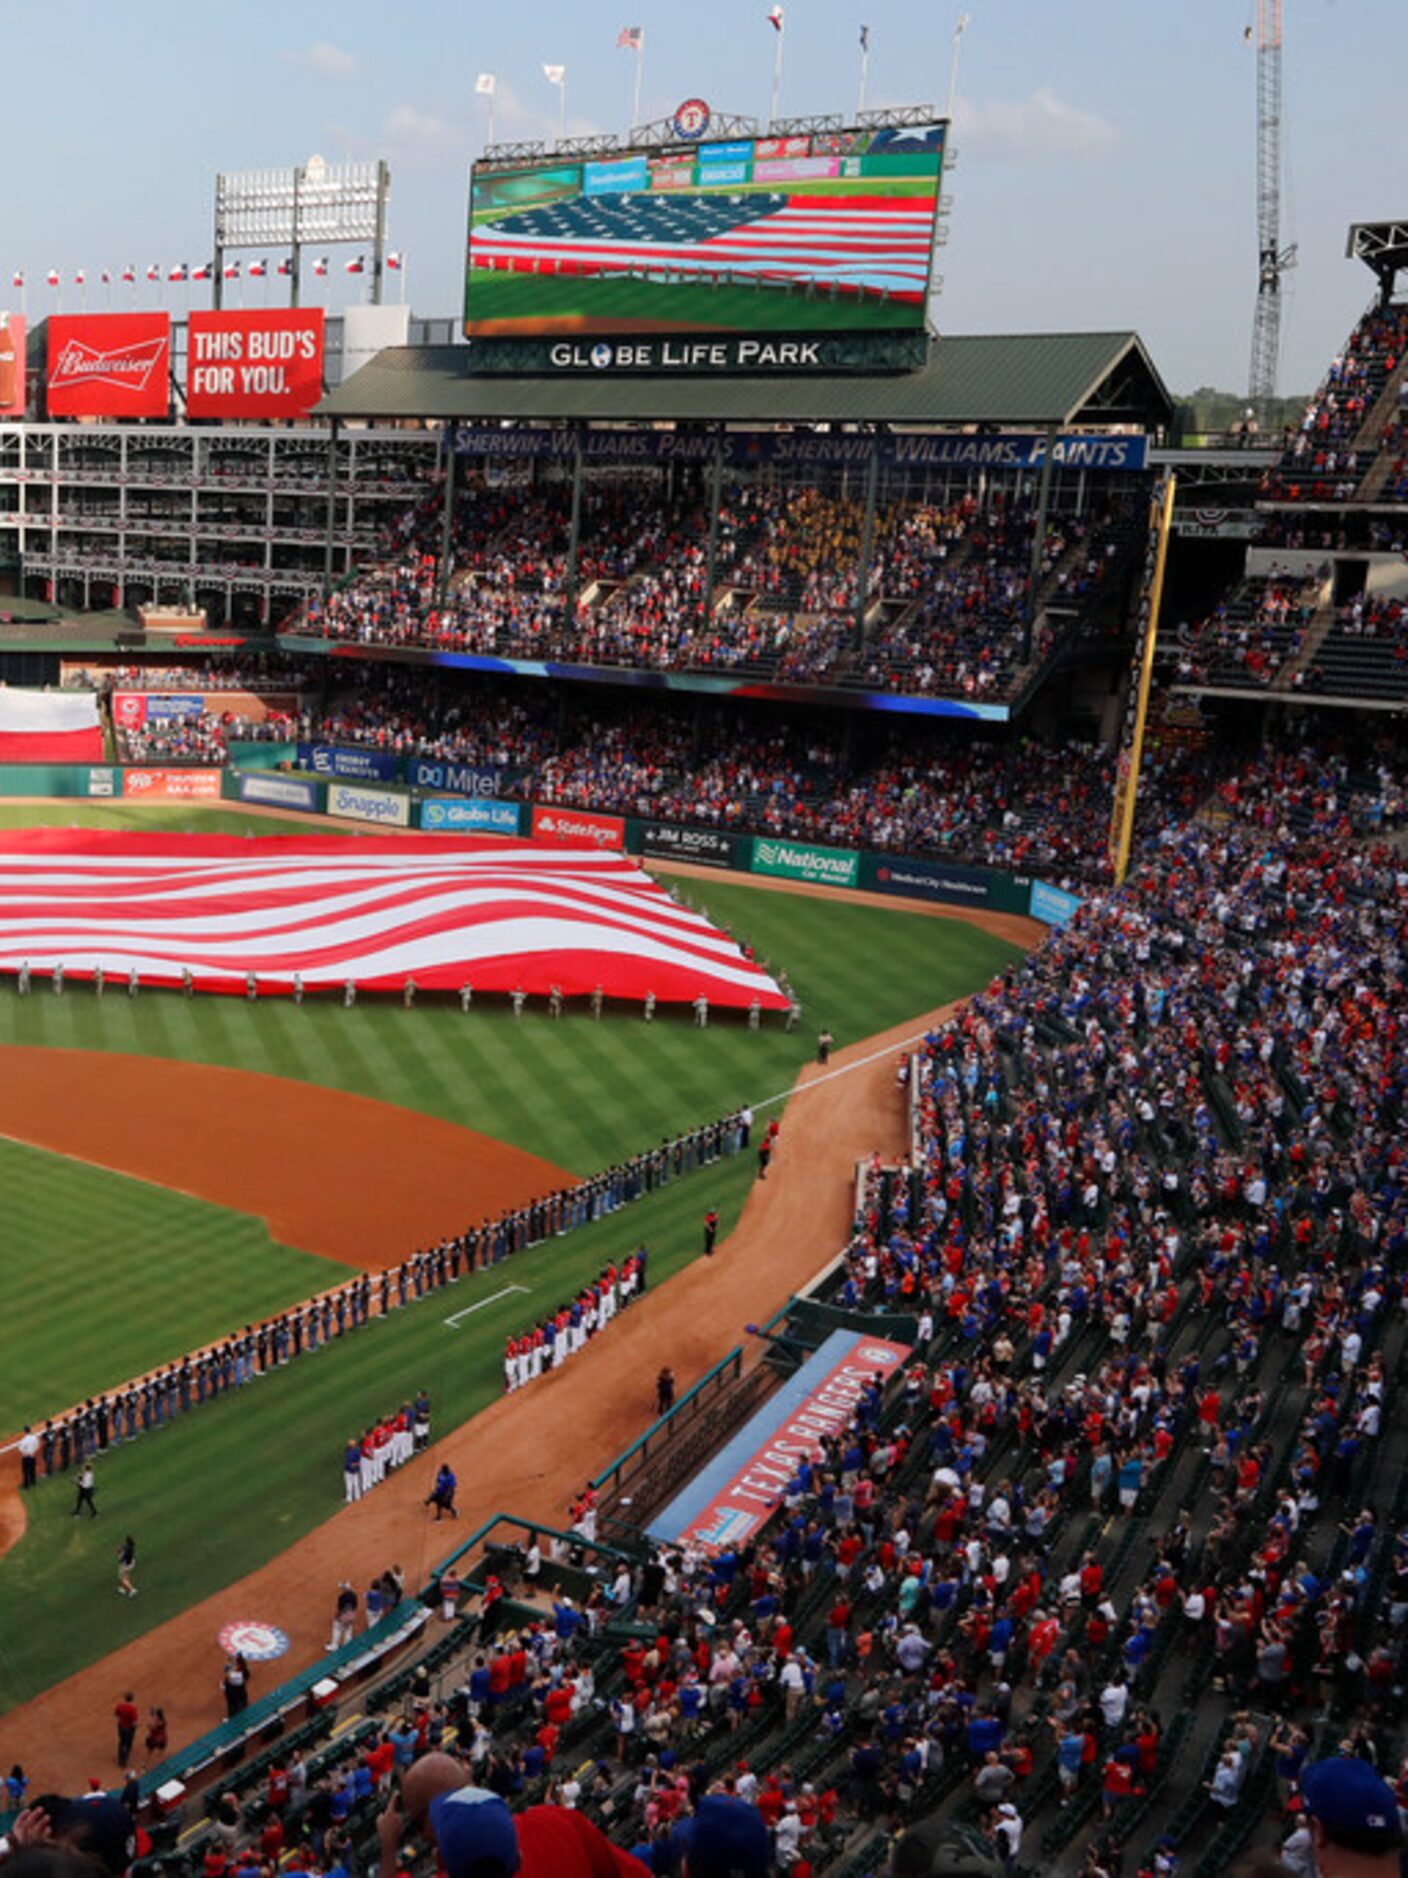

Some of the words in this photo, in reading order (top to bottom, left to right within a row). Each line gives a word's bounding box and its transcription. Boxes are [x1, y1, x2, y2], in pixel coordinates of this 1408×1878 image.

[194, 332, 243, 360] THIS
[248, 329, 316, 359] BUD'S
[662, 342, 728, 365] LIFE
[737, 340, 821, 365] PARK
[57, 351, 156, 376] Budweiser
[193, 367, 234, 394] FOR
[240, 366, 291, 394] YOU.
[335, 788, 400, 819] Snapple
[776, 849, 856, 875] National
